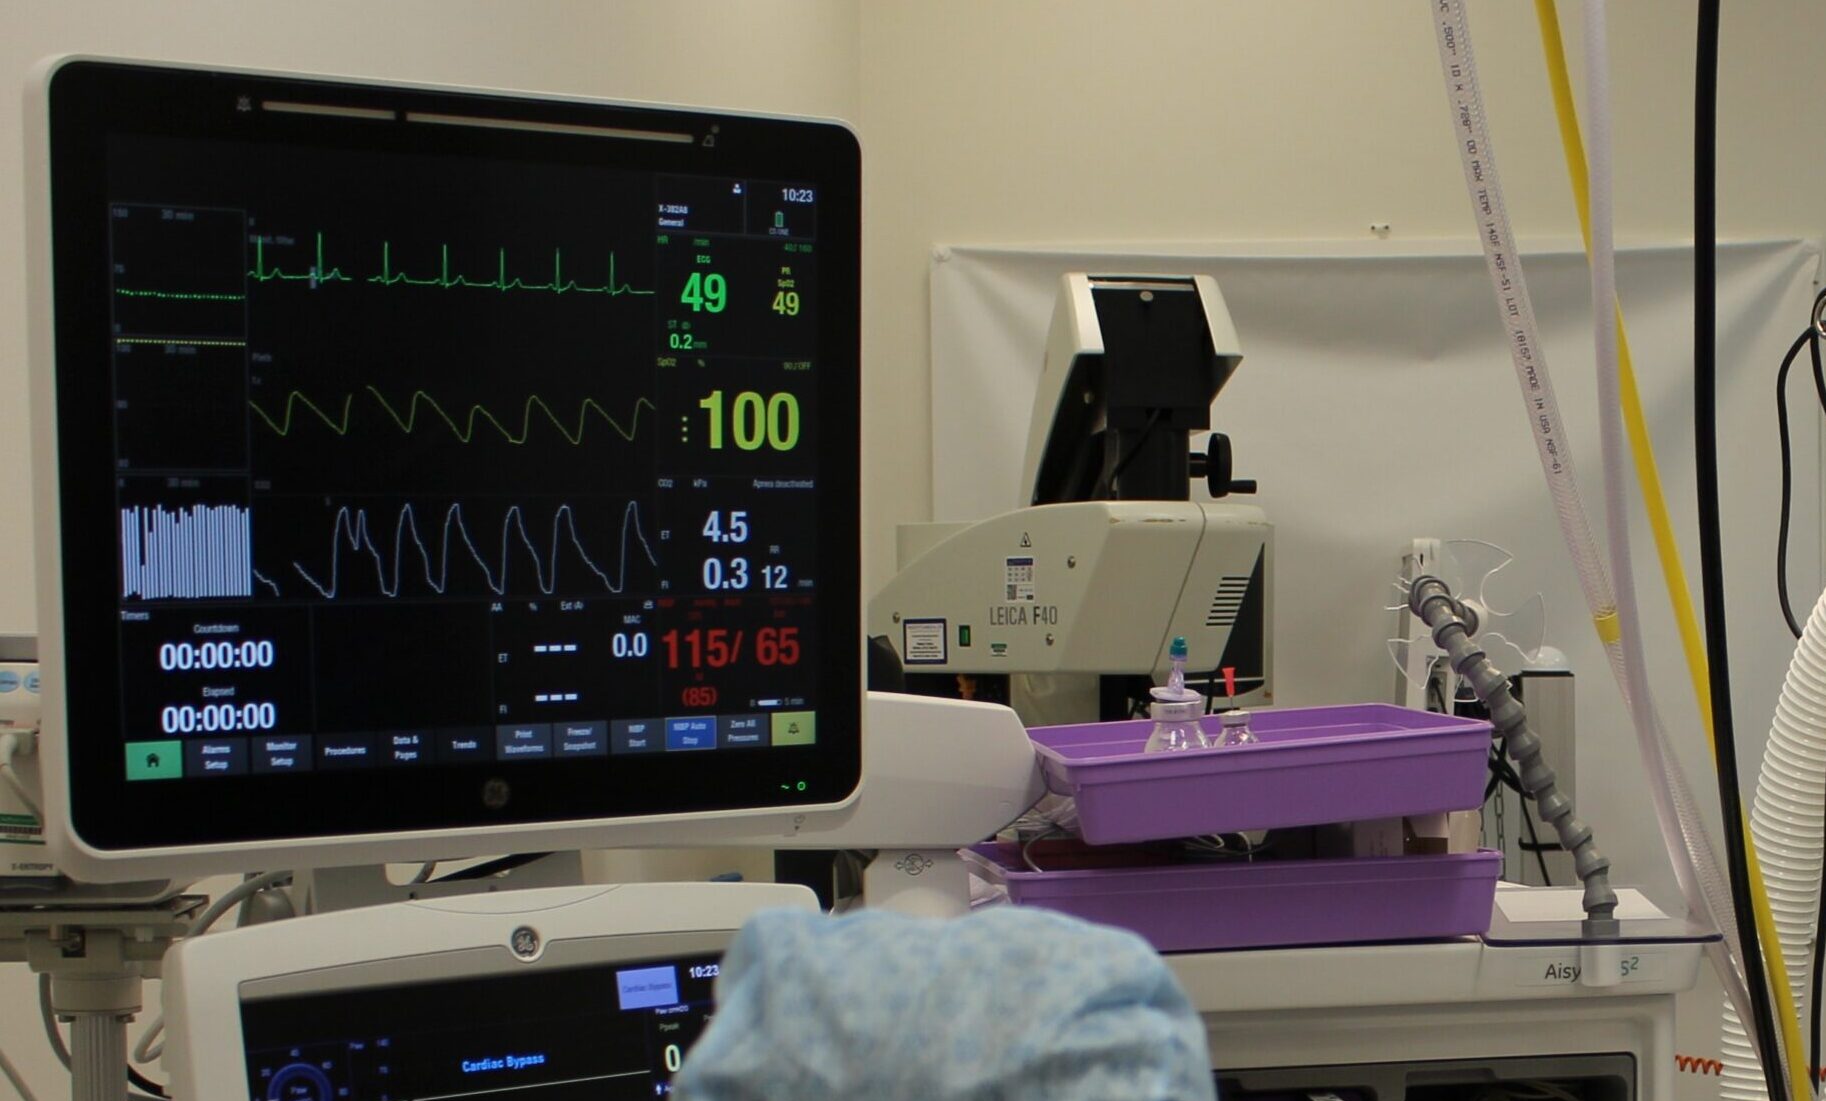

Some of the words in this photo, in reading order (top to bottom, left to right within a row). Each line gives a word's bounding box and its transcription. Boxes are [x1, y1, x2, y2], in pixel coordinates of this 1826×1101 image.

[782, 188, 813, 202] 10:23
[1478, 189, 1492, 215] TEMP
[681, 272, 727, 313] 49
[772, 291, 799, 315] 49
[669, 333, 692, 349] 0.2
[1526, 365, 1540, 390] MADE
[1535, 398, 1544, 409] IN
[700, 390, 800, 451] 100
[1539, 415, 1550, 434] USA
[702, 510, 748, 542] 4.5
[703, 557, 749, 590] 0.3
[761, 564, 787, 589] 12
[990, 606, 1028, 626] LEICA
[1033, 606, 1059, 626] F40
[193, 623, 240, 634] Countdown
[160, 640, 274, 671] 00:00:00
[612, 632, 648, 657] 0.0
[755, 626, 801, 666] 65
[203, 686, 235, 698] Elapsed
[681, 687, 719, 708] (85)
[162, 702, 275, 734] 00:00:00
[204, 759, 229, 771] Setup
[271, 756, 294, 768] Setup
[689, 965, 720, 978] 10:23
[462, 1057, 504, 1073] Cardiac
[506, 1054, 545, 1070] Bypass
[665, 1044, 681, 1073] 0
